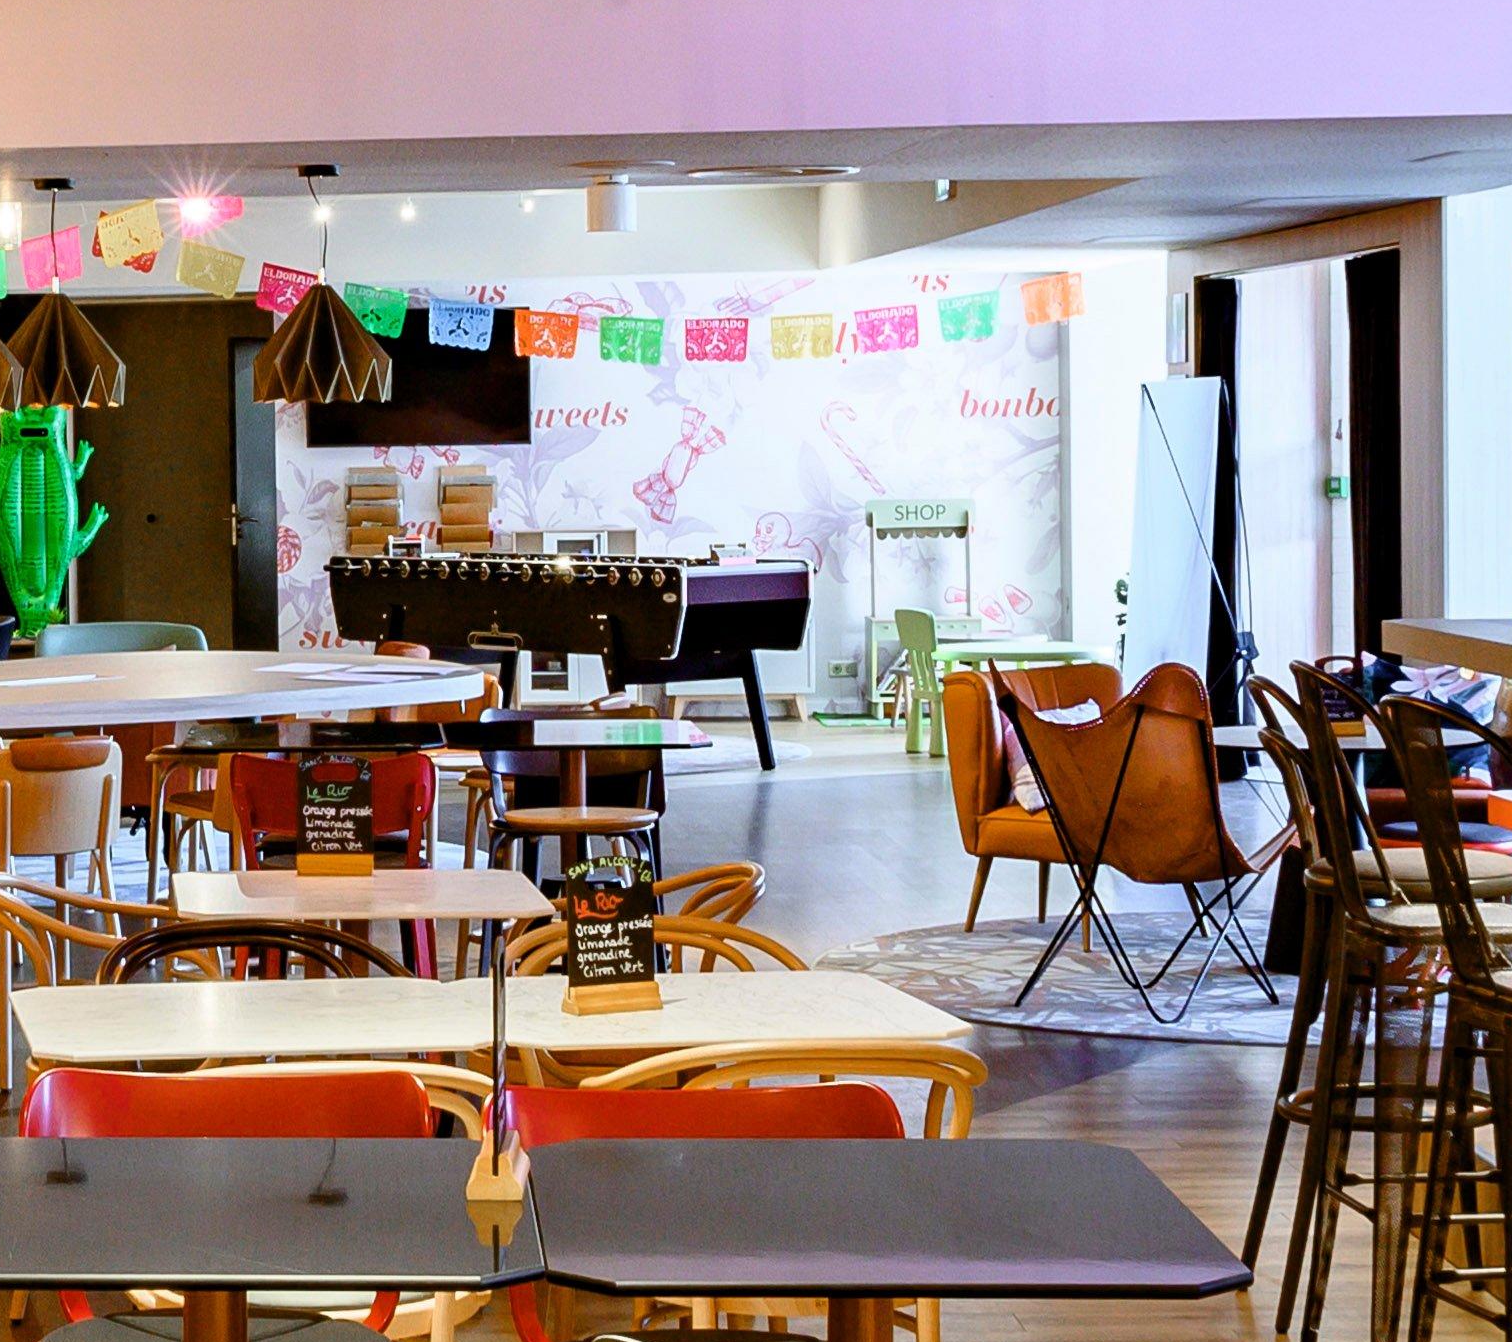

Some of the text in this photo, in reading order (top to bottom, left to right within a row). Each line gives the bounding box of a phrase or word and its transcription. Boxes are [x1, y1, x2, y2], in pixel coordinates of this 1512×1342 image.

[773, 317, 830, 328] ELDORADO
[856, 308, 914, 323] ELDORADO
[686, 319, 746, 330] ELDORADO
[894, 504, 946, 521] SHOP
[327, 784, 352, 796] Rio
[303, 805, 336, 819] Orange
[306, 829, 356, 842] grenadine
[599, 857, 636, 868] ALCOOL
[573, 891, 624, 916] Le Rio
[576, 923, 614, 938] Orange
[577, 948, 633, 969] grenadine
